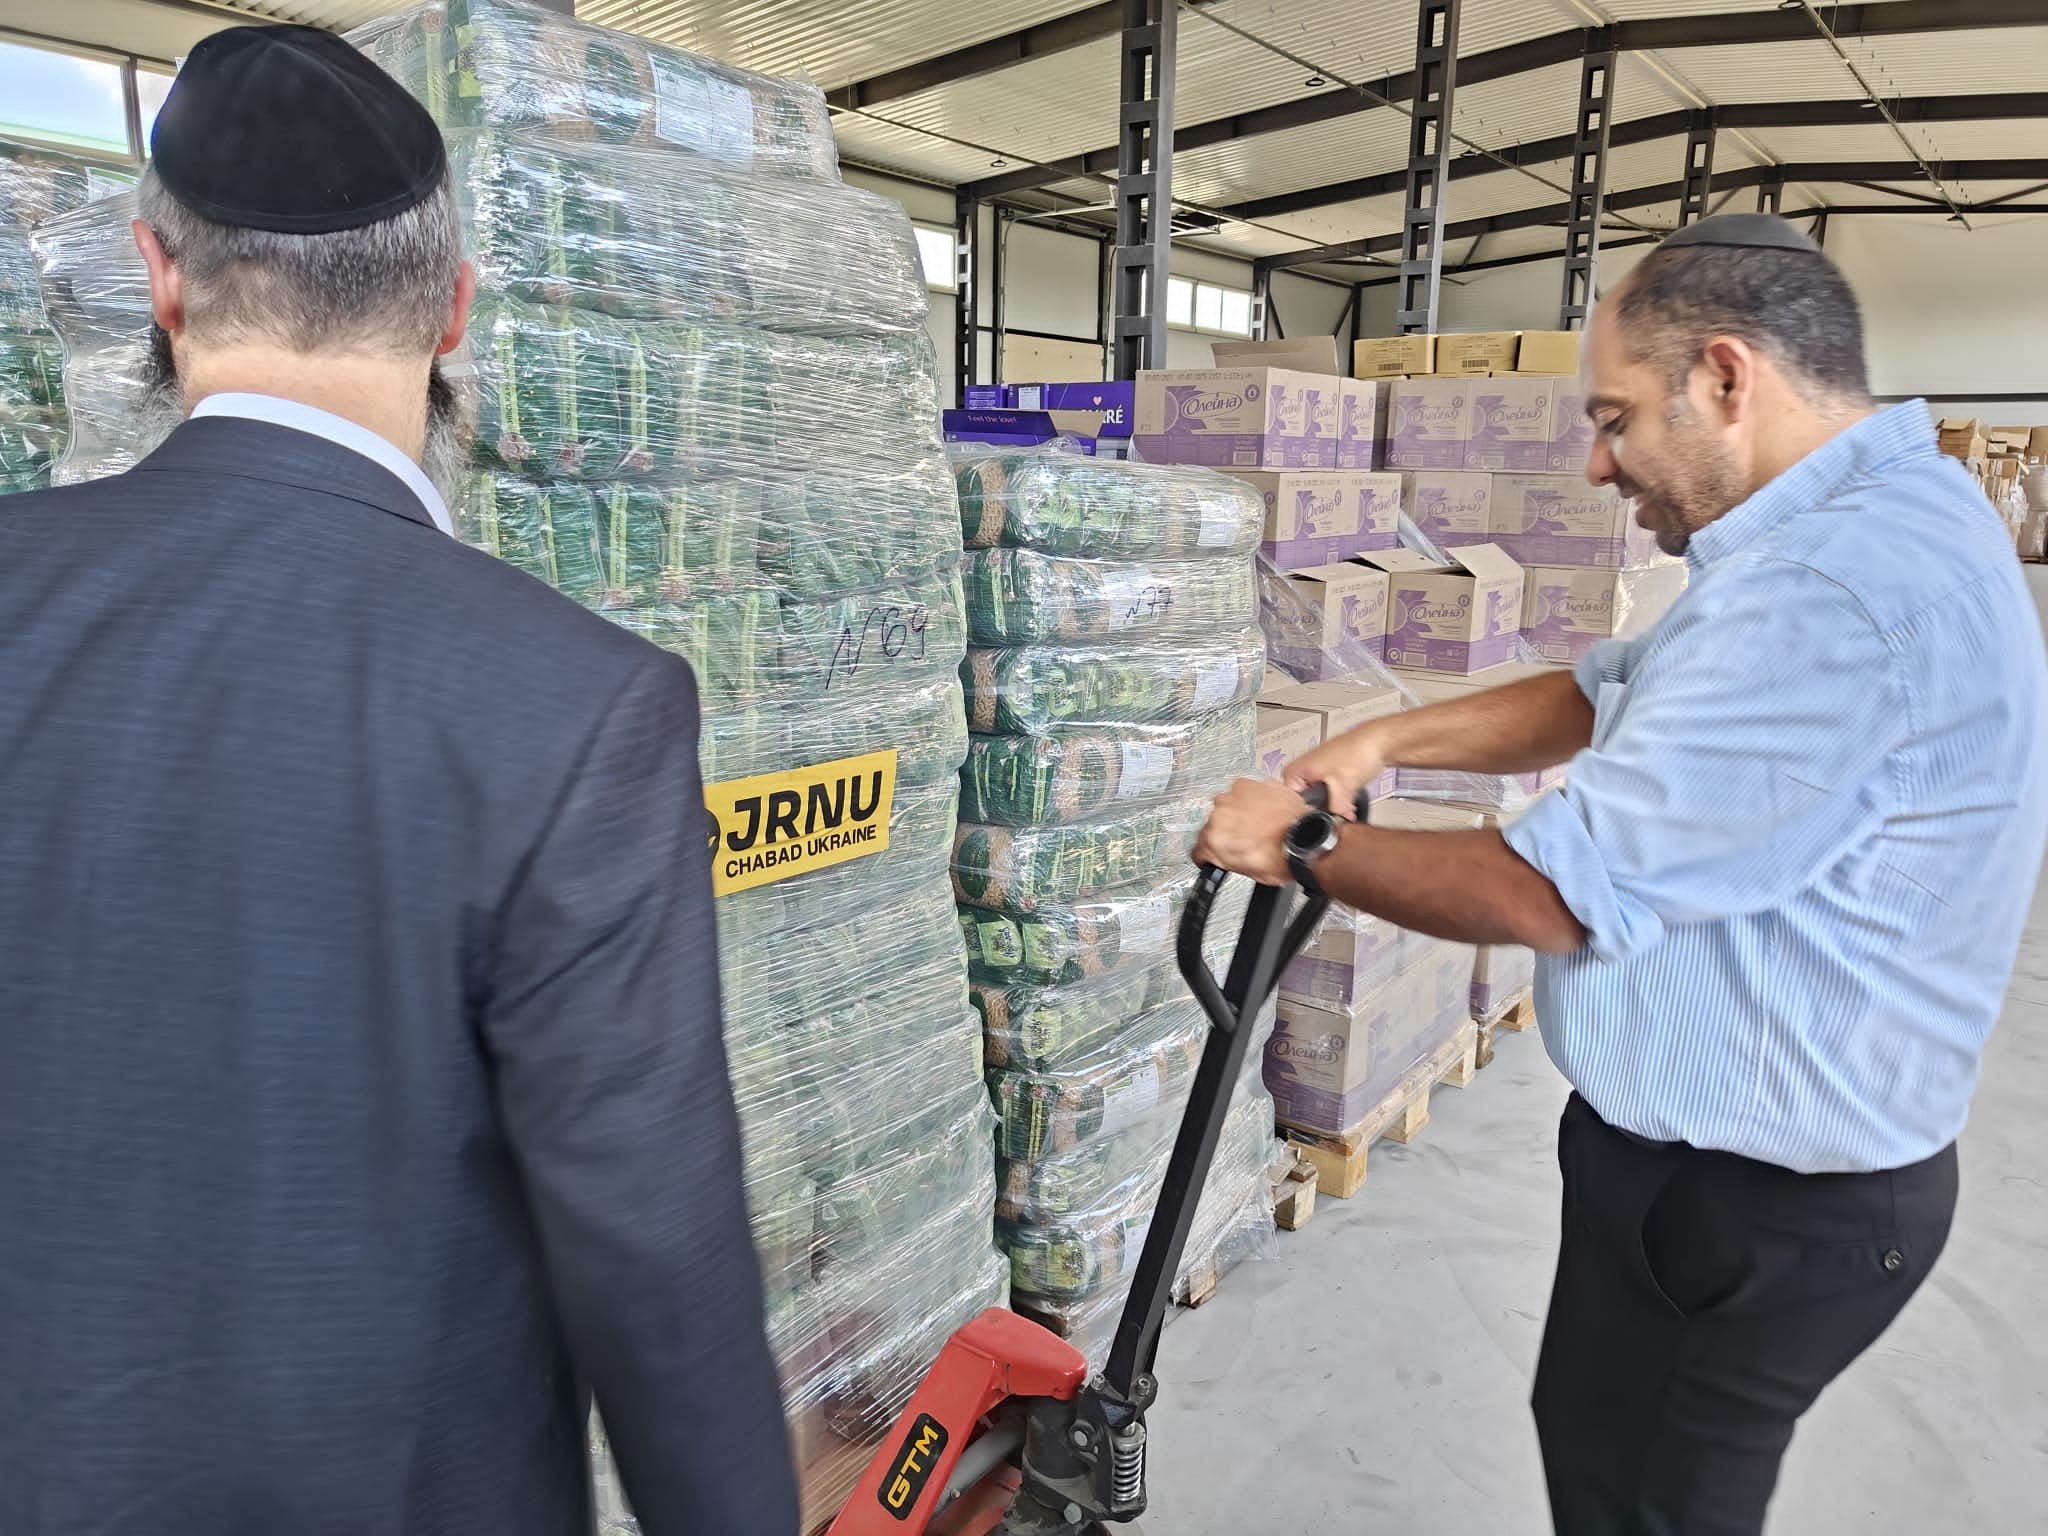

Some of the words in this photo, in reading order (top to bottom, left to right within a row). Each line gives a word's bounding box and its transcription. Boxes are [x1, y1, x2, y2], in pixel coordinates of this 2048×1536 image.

[725, 843, 803, 878] CHABAD
[808, 823, 877, 857] UKRAINE
[726, 770, 883, 852] JRNU
[886, 1424, 939, 1508] GTM
